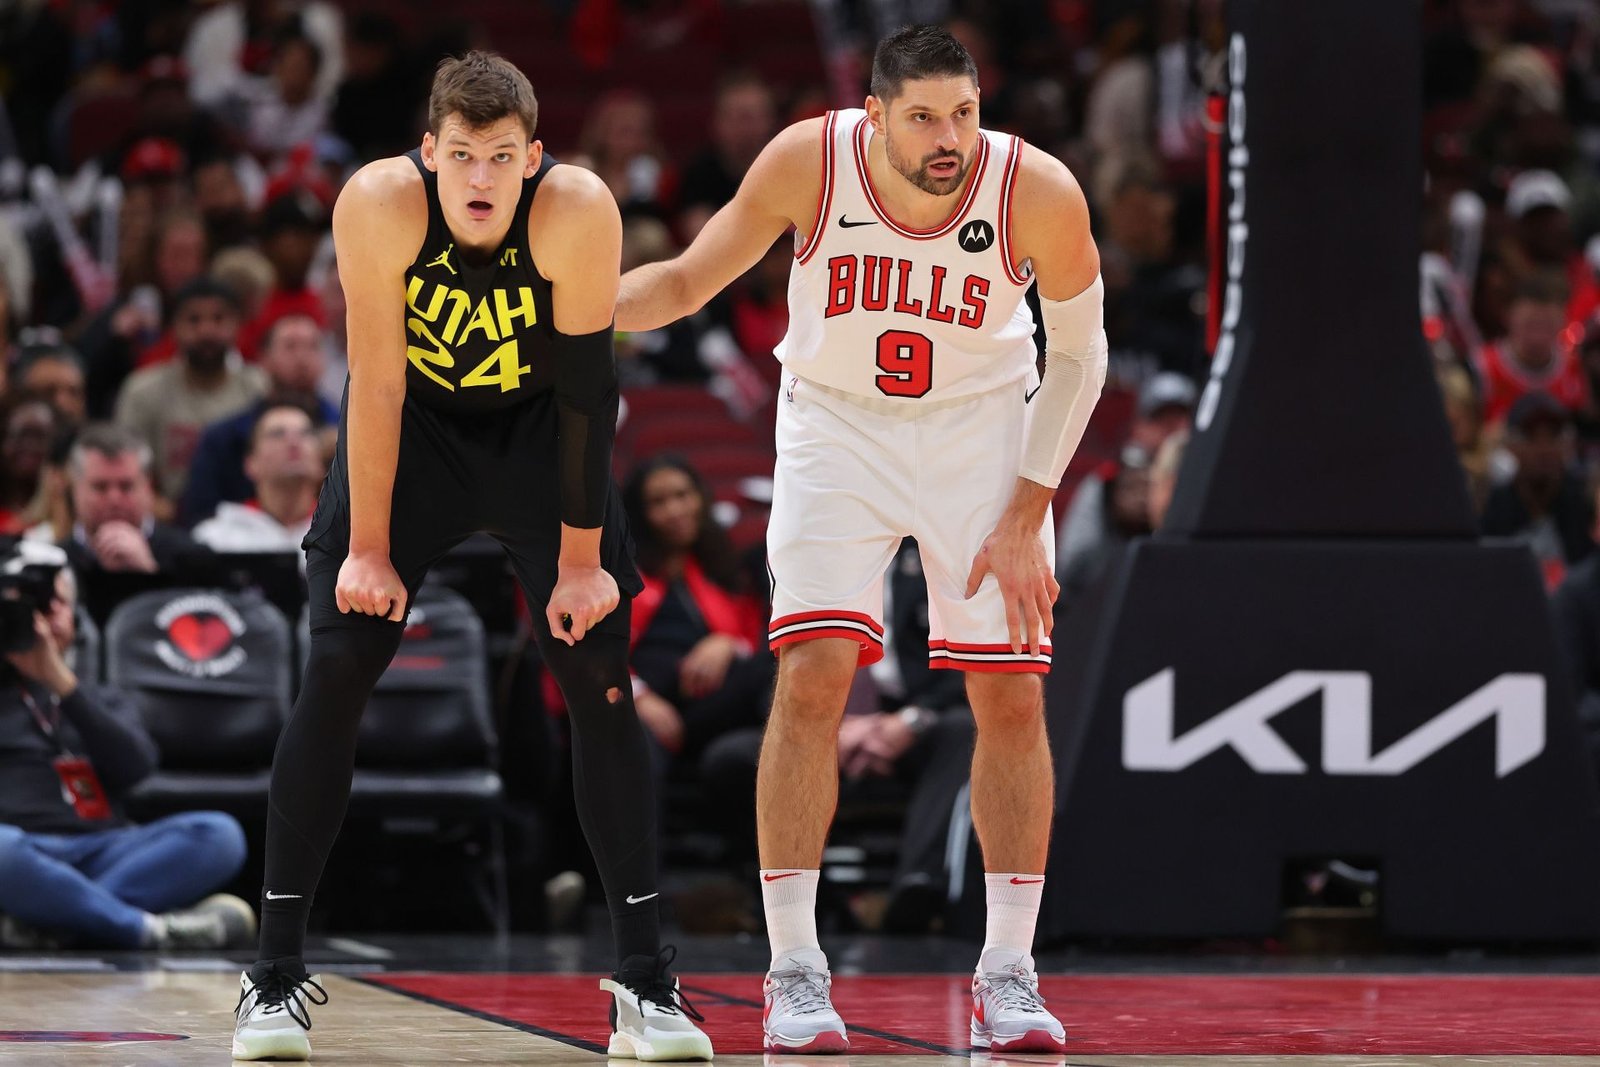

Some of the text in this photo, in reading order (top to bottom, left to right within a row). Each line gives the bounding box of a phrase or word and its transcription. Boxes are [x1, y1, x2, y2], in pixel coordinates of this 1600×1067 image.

[406, 275, 537, 348] UTAH
[825, 254, 990, 329] BULLS
[406, 317, 531, 394] 24
[875, 329, 933, 398] 9
[1122, 667, 1546, 778] KIA
